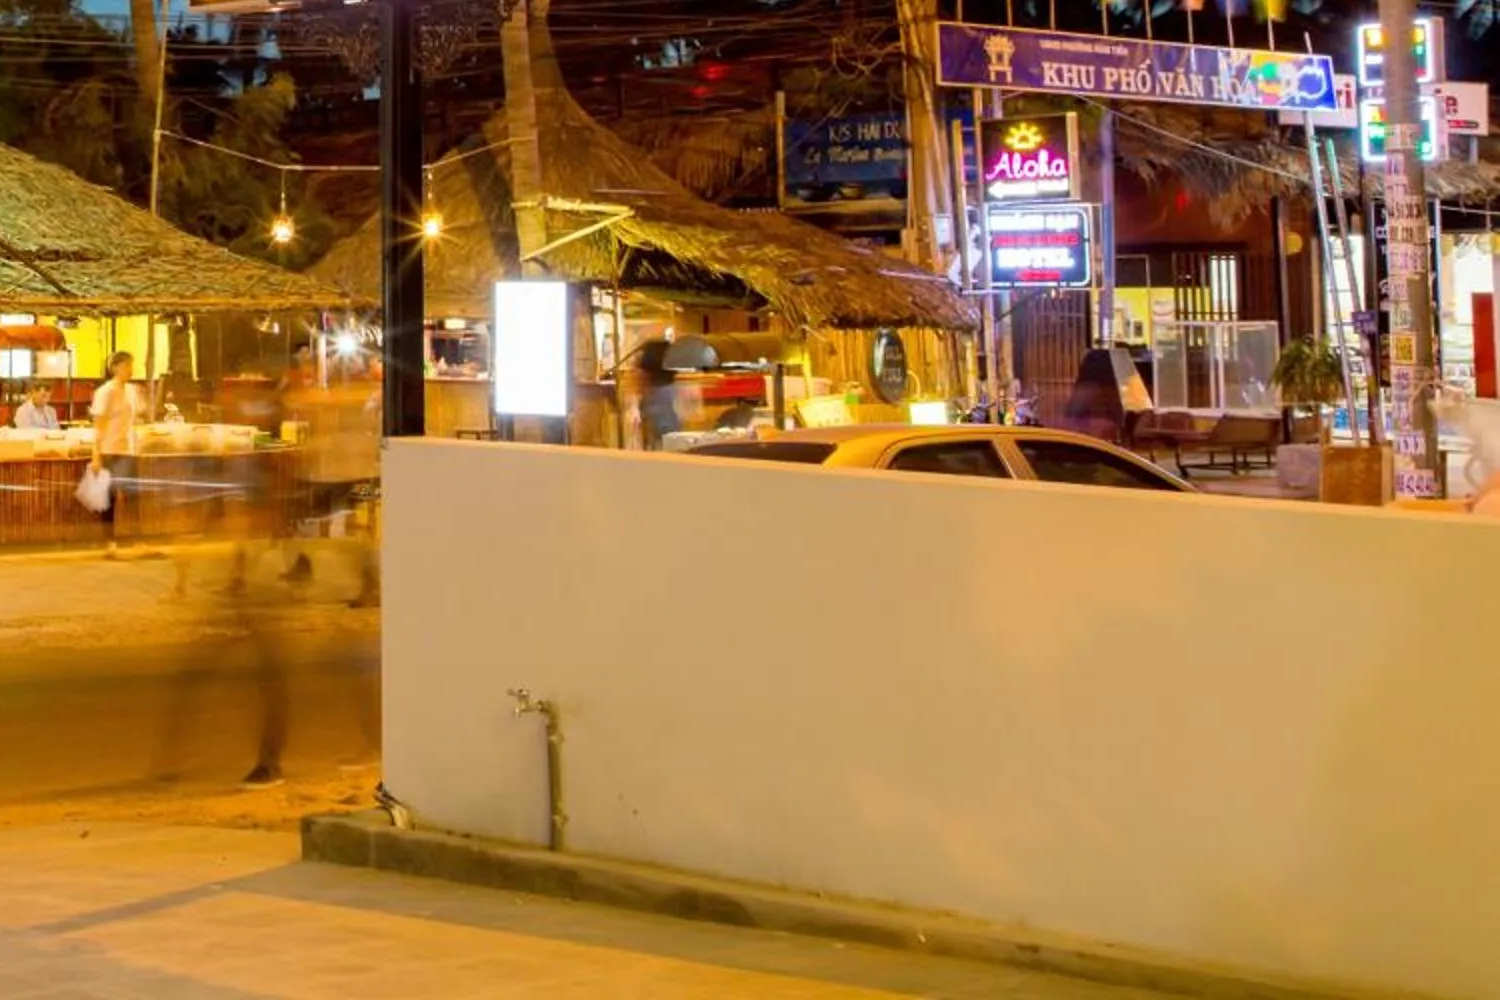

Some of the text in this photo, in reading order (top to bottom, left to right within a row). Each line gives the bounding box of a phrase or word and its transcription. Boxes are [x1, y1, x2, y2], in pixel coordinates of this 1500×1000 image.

[1041, 62, 1095, 89] KHU
[1102, 58, 1152, 93] PHỐ
[1158, 67, 1204, 98] VĂN
[986, 149, 1068, 180] Aloha
